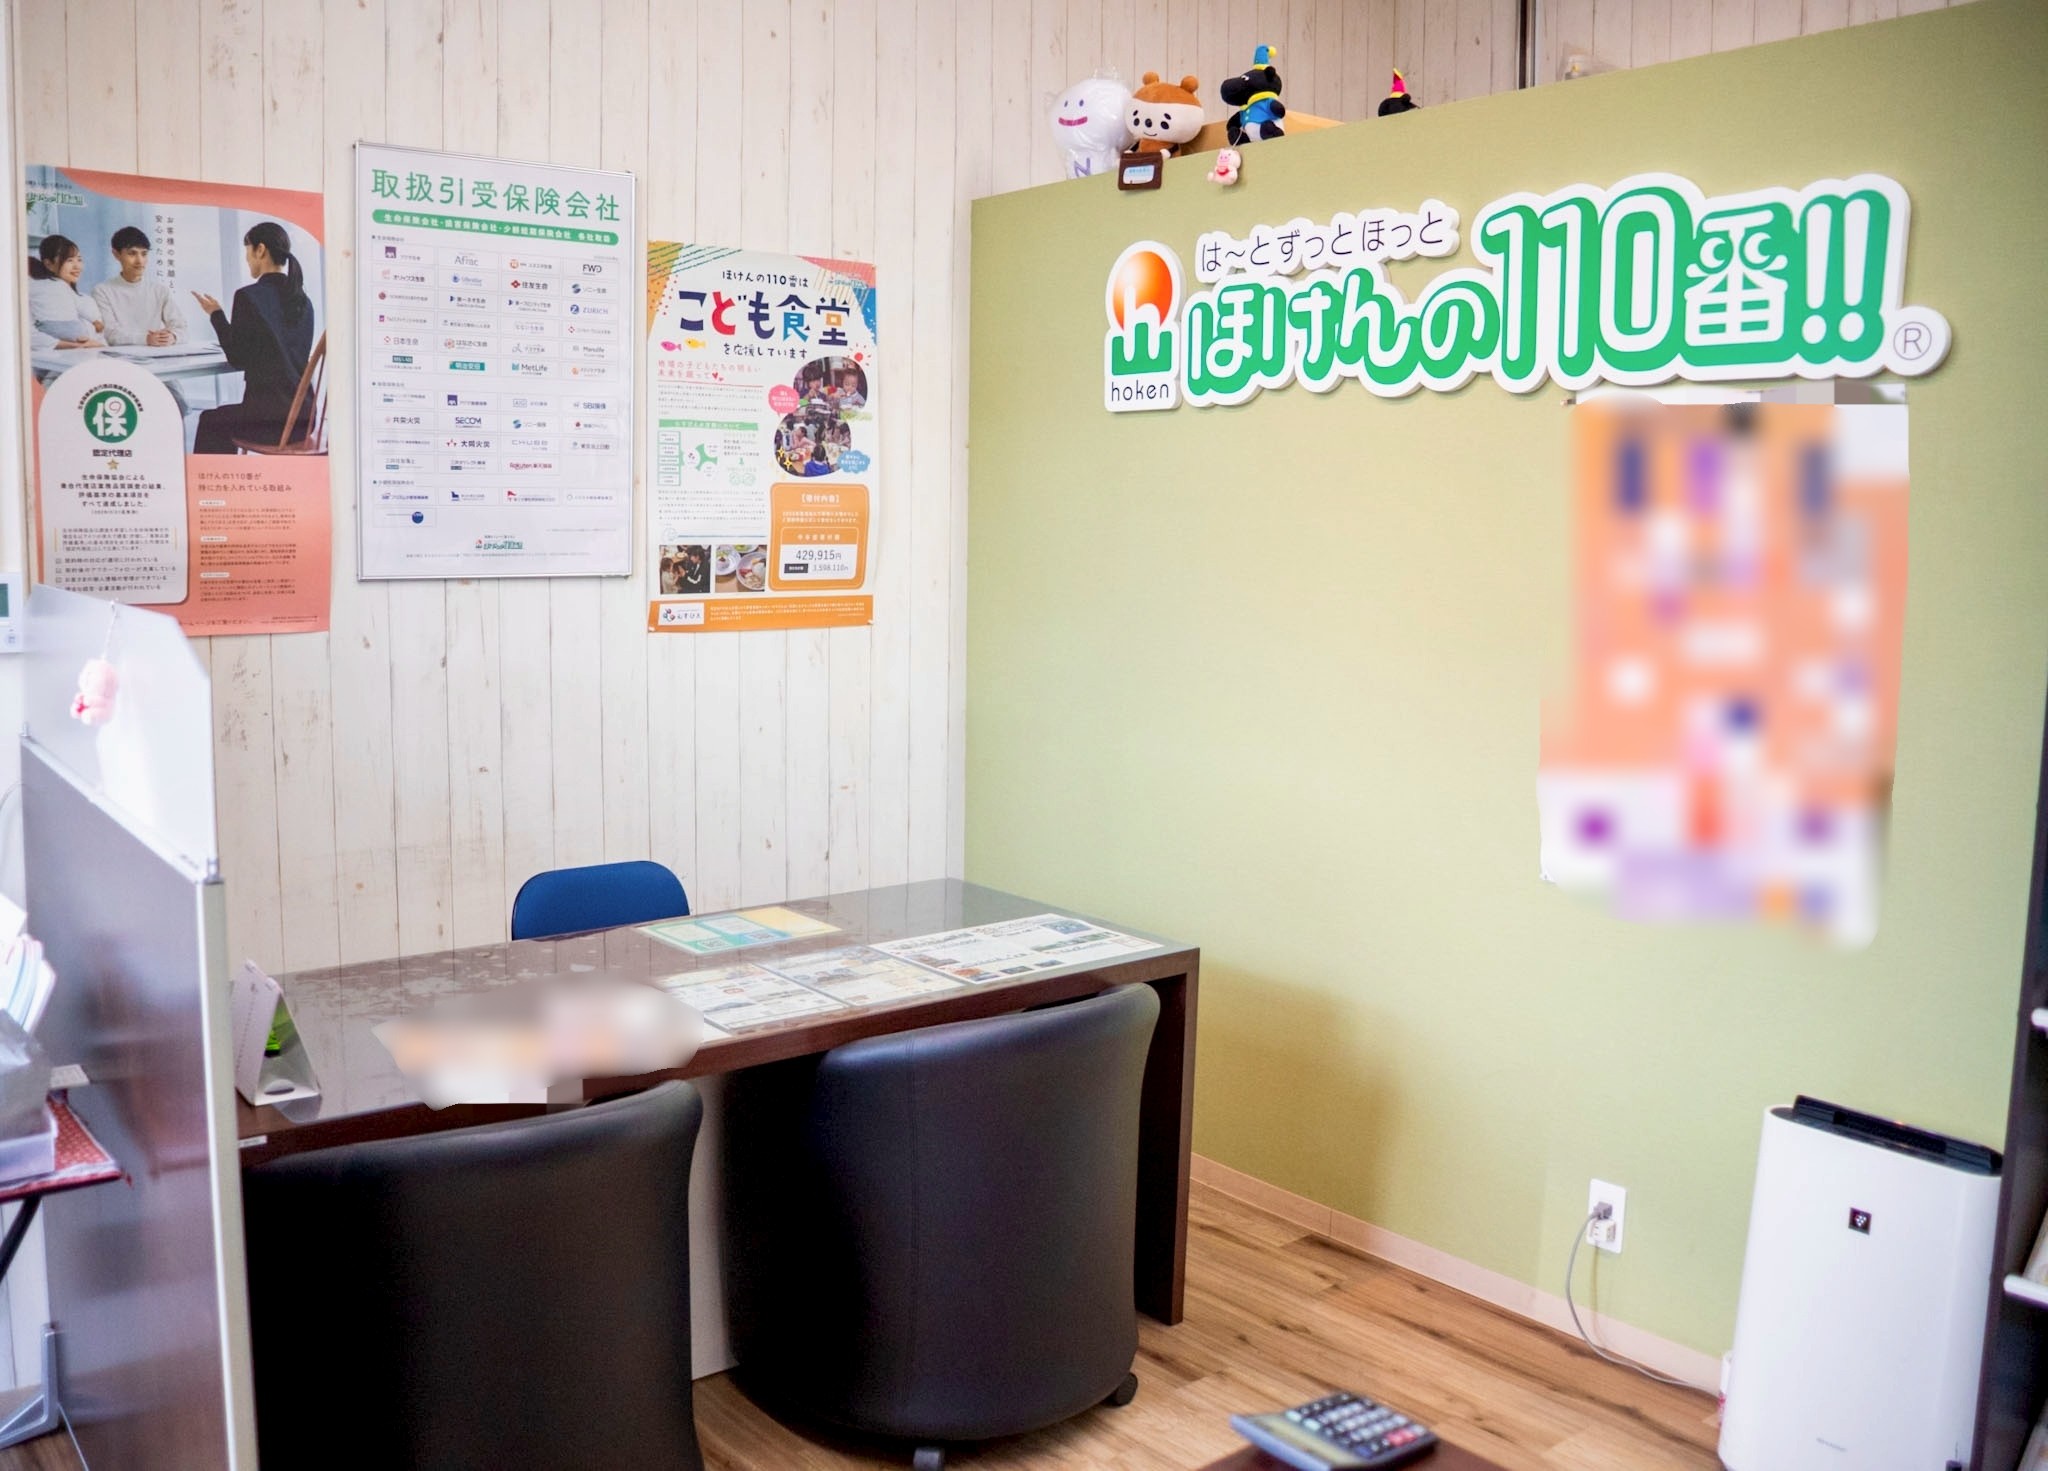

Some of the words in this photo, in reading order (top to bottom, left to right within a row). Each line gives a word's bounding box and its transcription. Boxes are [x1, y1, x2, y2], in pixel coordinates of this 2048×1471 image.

[371, 168, 621, 221] 取扱引受保険会社
[582, 263, 602, 273] FWD
[722, 269, 809, 288] ほけんの110番は
[522, 281, 548, 290] 住友生命
[582, 306, 609, 315] ZURICH
[678, 290, 851, 347] こども食堂
[393, 337, 419, 346] 日本生命
[723, 343, 808, 360] を応援しています
[521, 363, 548, 372] MetLife
[1110, 379, 1170, 402] hoken
[455, 416, 482, 424] SECOM
[92, 449, 133, 457] 認定代理店
[198, 472, 262, 481] ほけんの110番が
